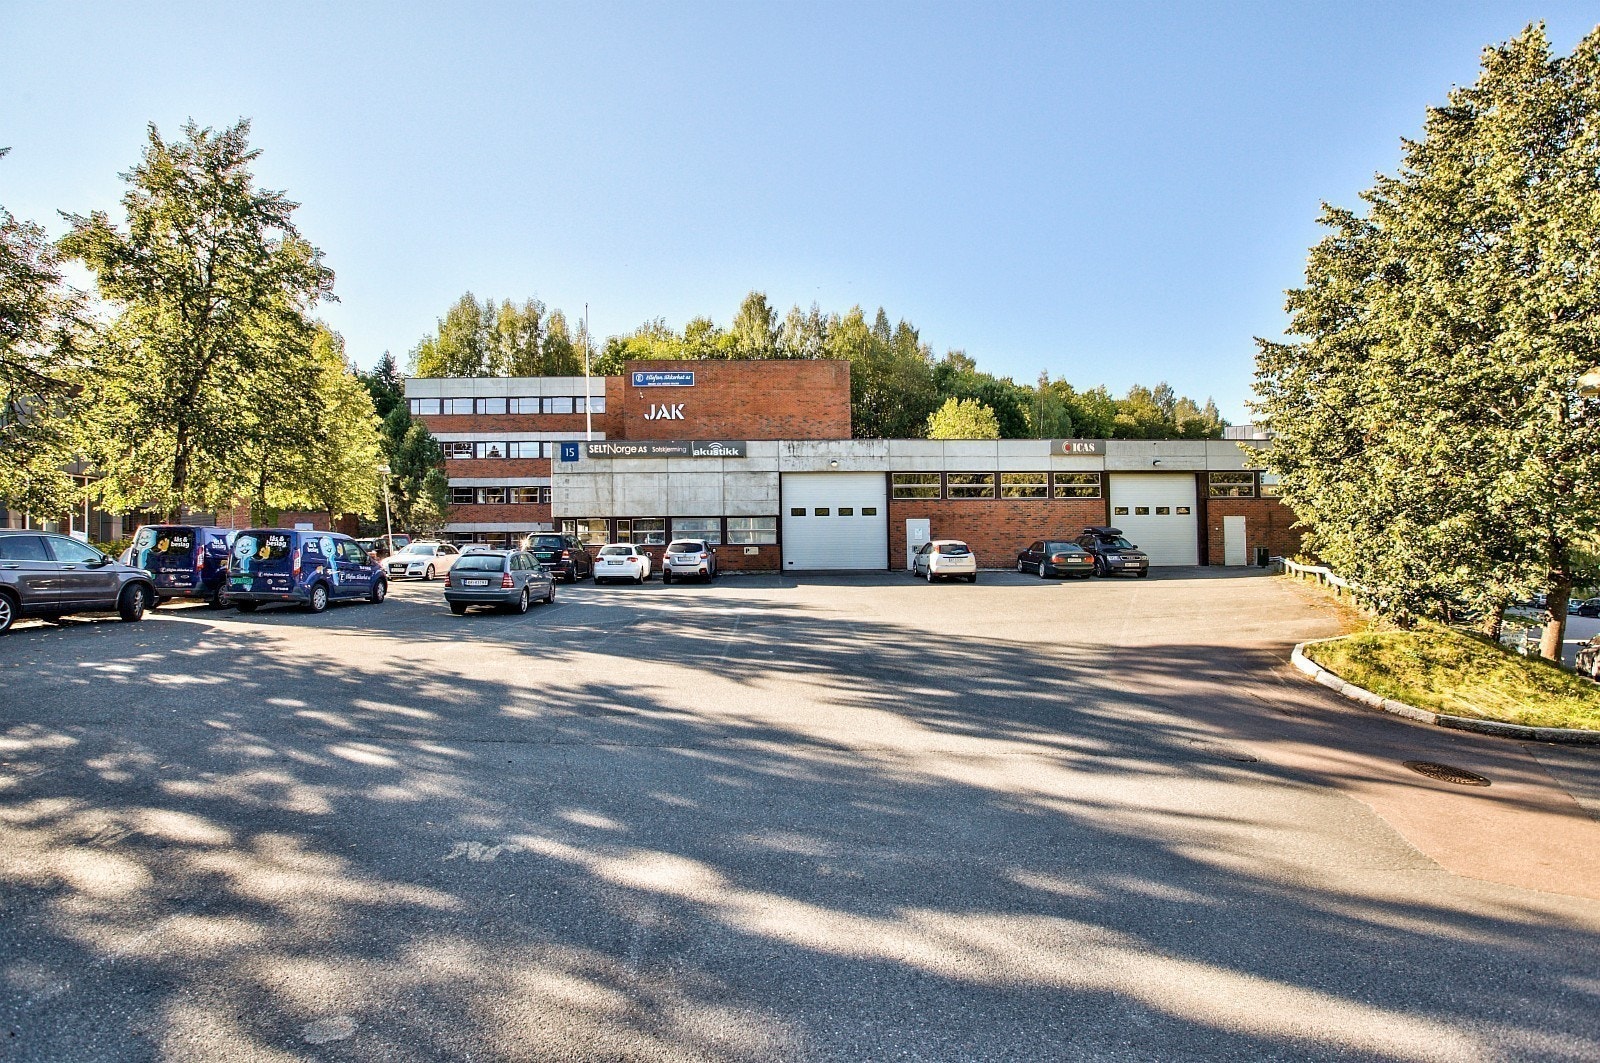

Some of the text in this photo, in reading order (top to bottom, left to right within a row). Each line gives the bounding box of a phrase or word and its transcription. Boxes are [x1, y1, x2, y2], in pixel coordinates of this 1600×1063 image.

[644, 403, 684, 420] JAK
[565, 447, 575, 457] 15
[693, 447, 739, 456] akustikk
[1072, 443, 1095, 452] ICAS
